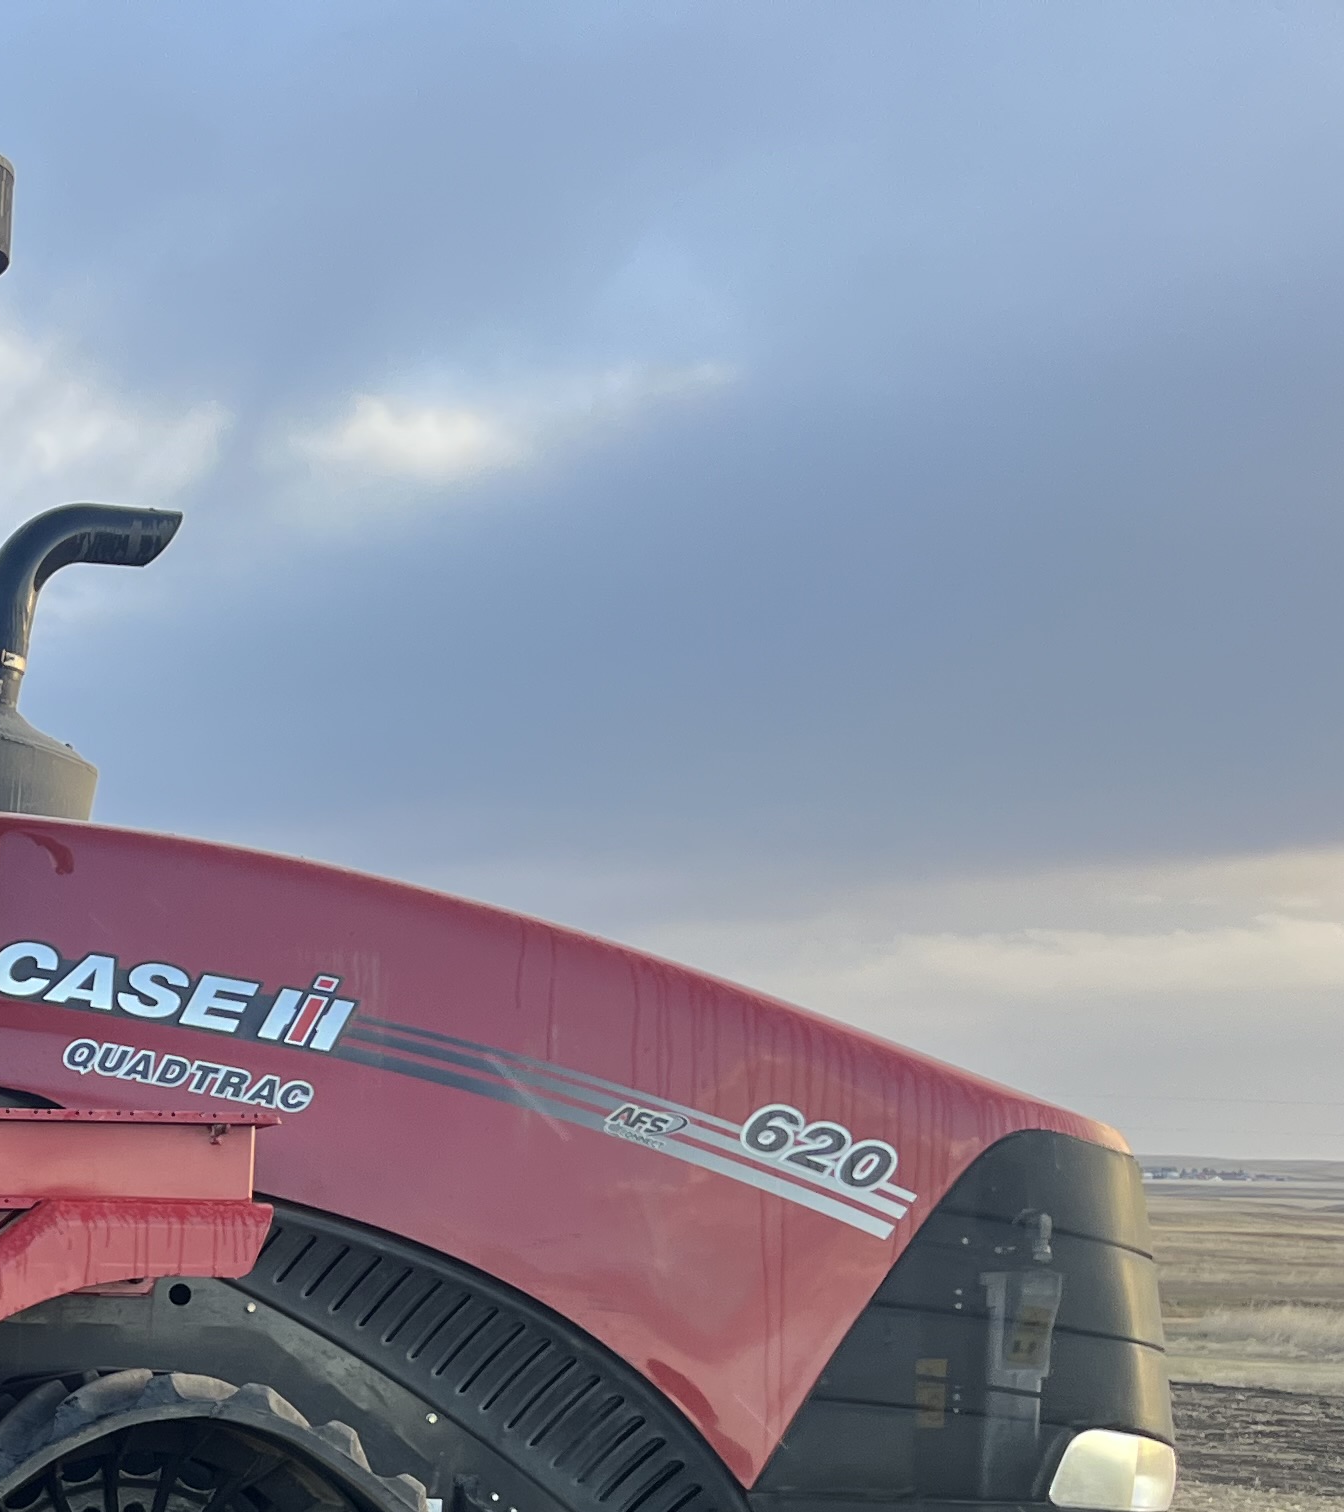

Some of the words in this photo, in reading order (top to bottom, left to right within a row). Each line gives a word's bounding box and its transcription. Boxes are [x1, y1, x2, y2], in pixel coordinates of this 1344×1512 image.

[62, 1037, 315, 1113] QUADTRAC
[604, 1103, 675, 1133] AFS
[739, 1103, 899, 1193] 620
